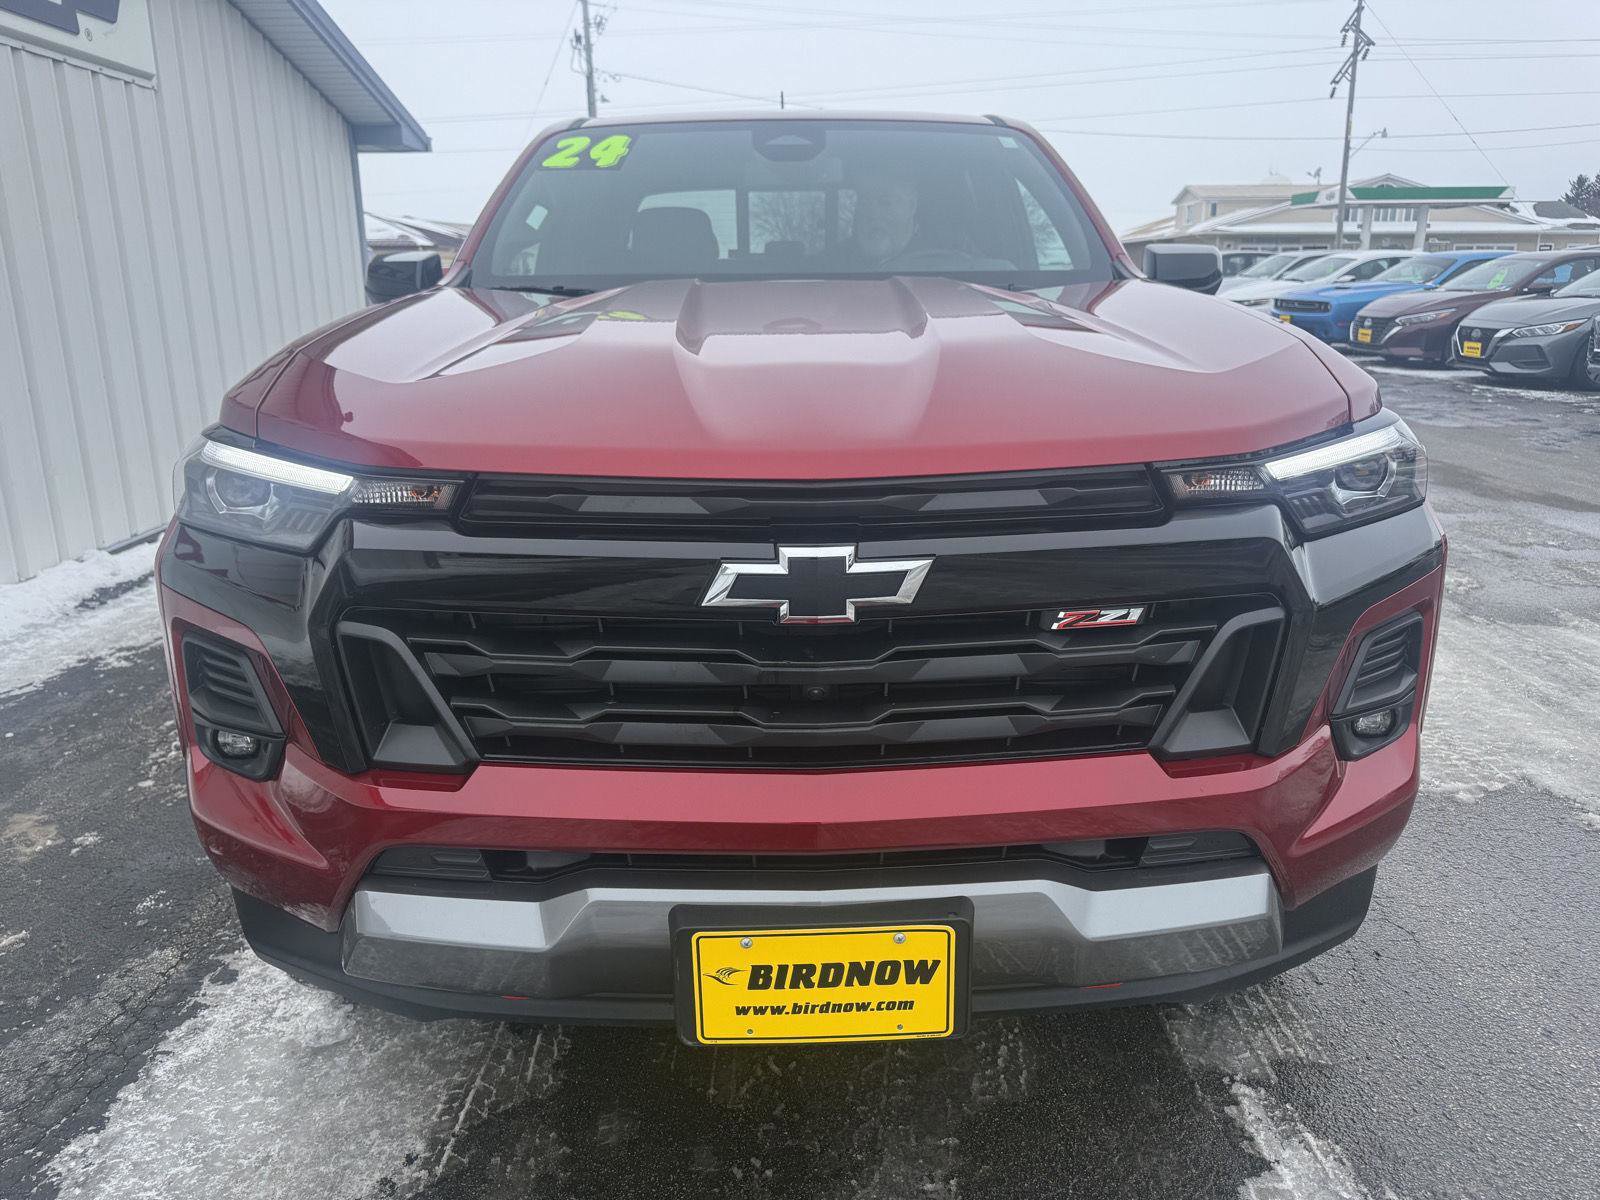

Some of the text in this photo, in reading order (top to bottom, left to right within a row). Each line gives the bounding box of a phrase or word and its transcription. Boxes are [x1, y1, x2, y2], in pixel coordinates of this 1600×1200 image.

[542, 135, 631, 168] 24
[1051, 608, 1144, 630] Z71
[747, 960, 941, 990] BIRDNOW
[735, 1000, 914, 1016] www.birdnow.com
